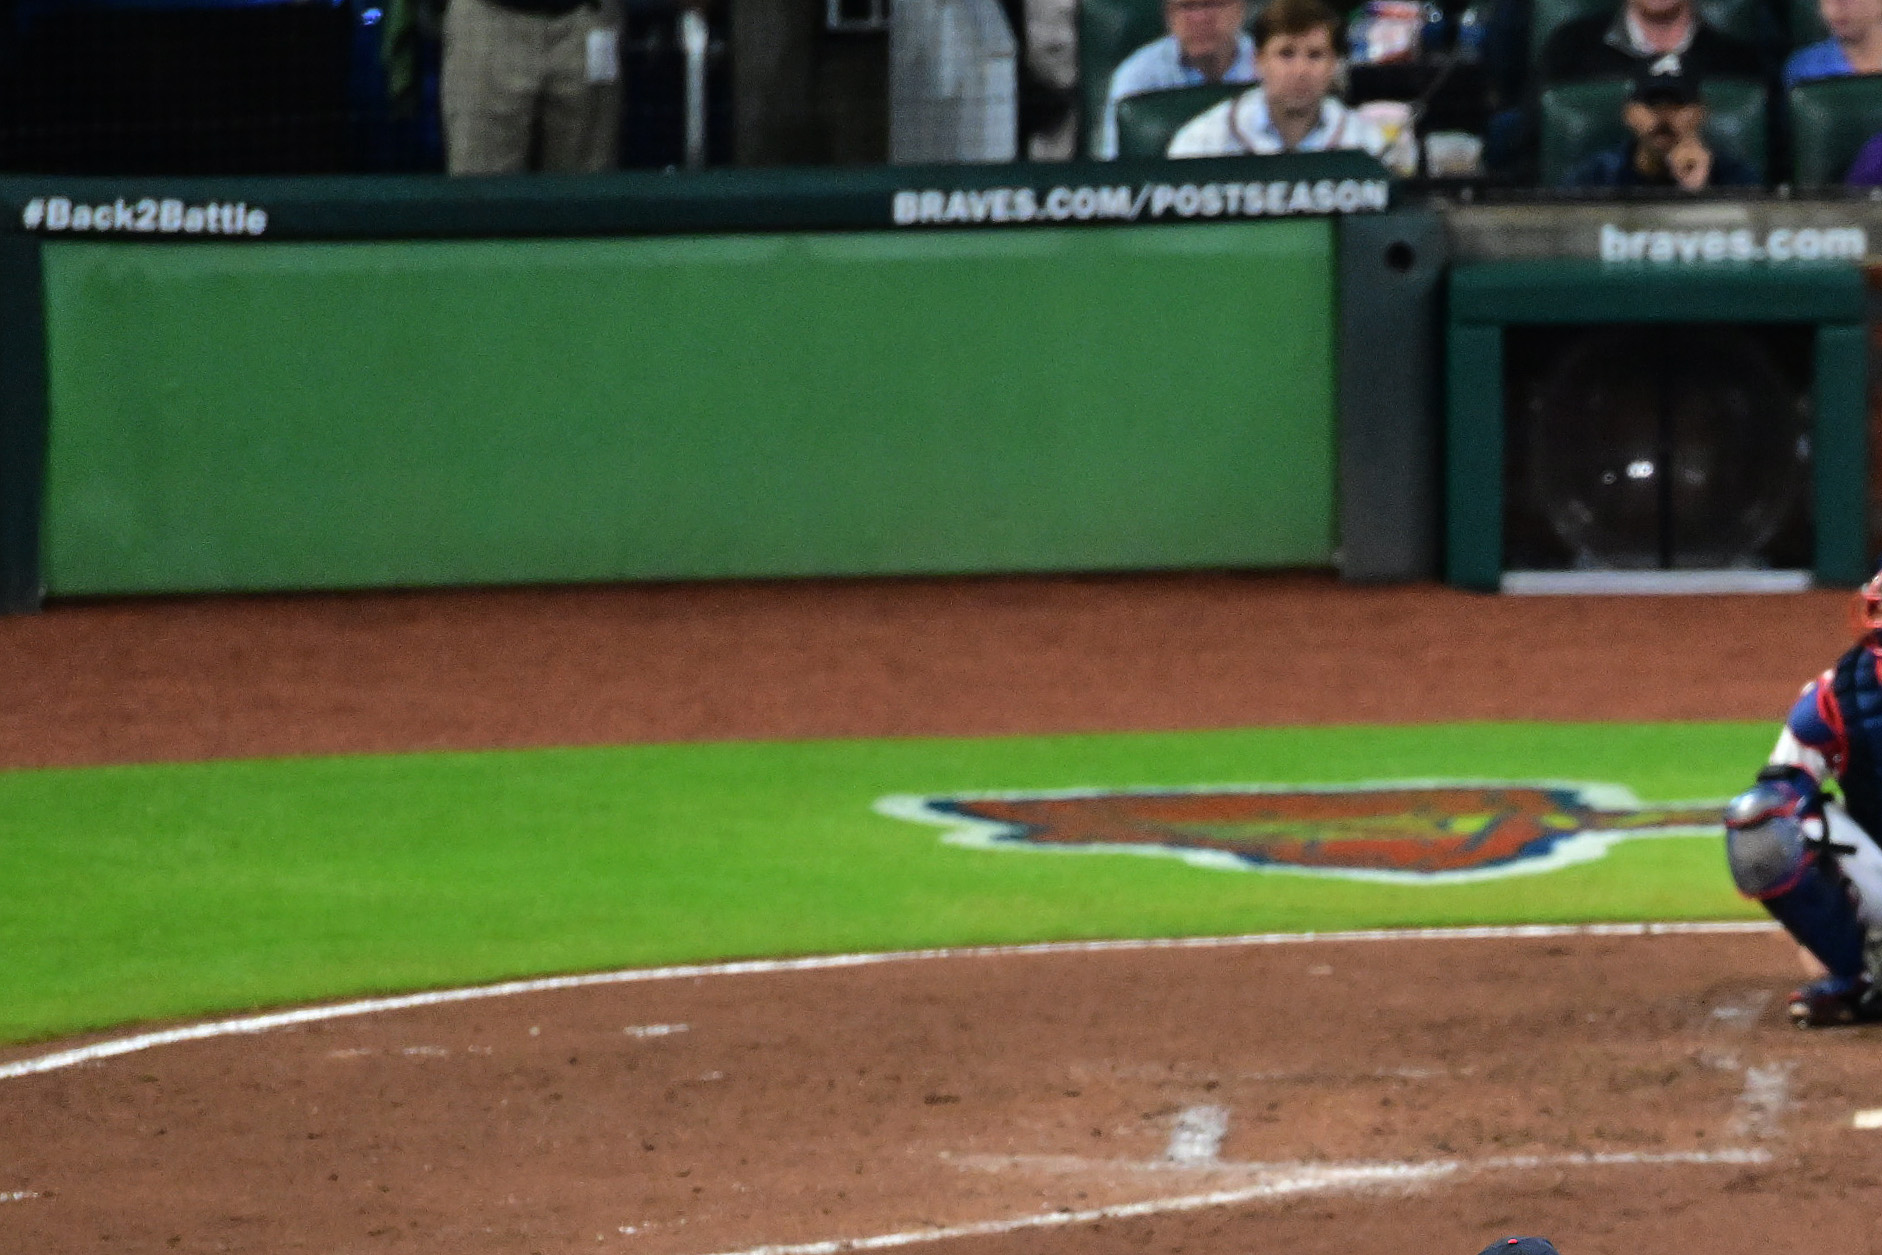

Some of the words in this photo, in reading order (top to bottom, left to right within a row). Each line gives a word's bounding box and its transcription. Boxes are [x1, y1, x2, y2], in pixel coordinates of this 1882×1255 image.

[23, 196, 268, 236] #Back2Battle
[893, 179, 1388, 225] BRAVES.COM/POSTSEASON
[1601, 223, 1866, 263] braves.com
